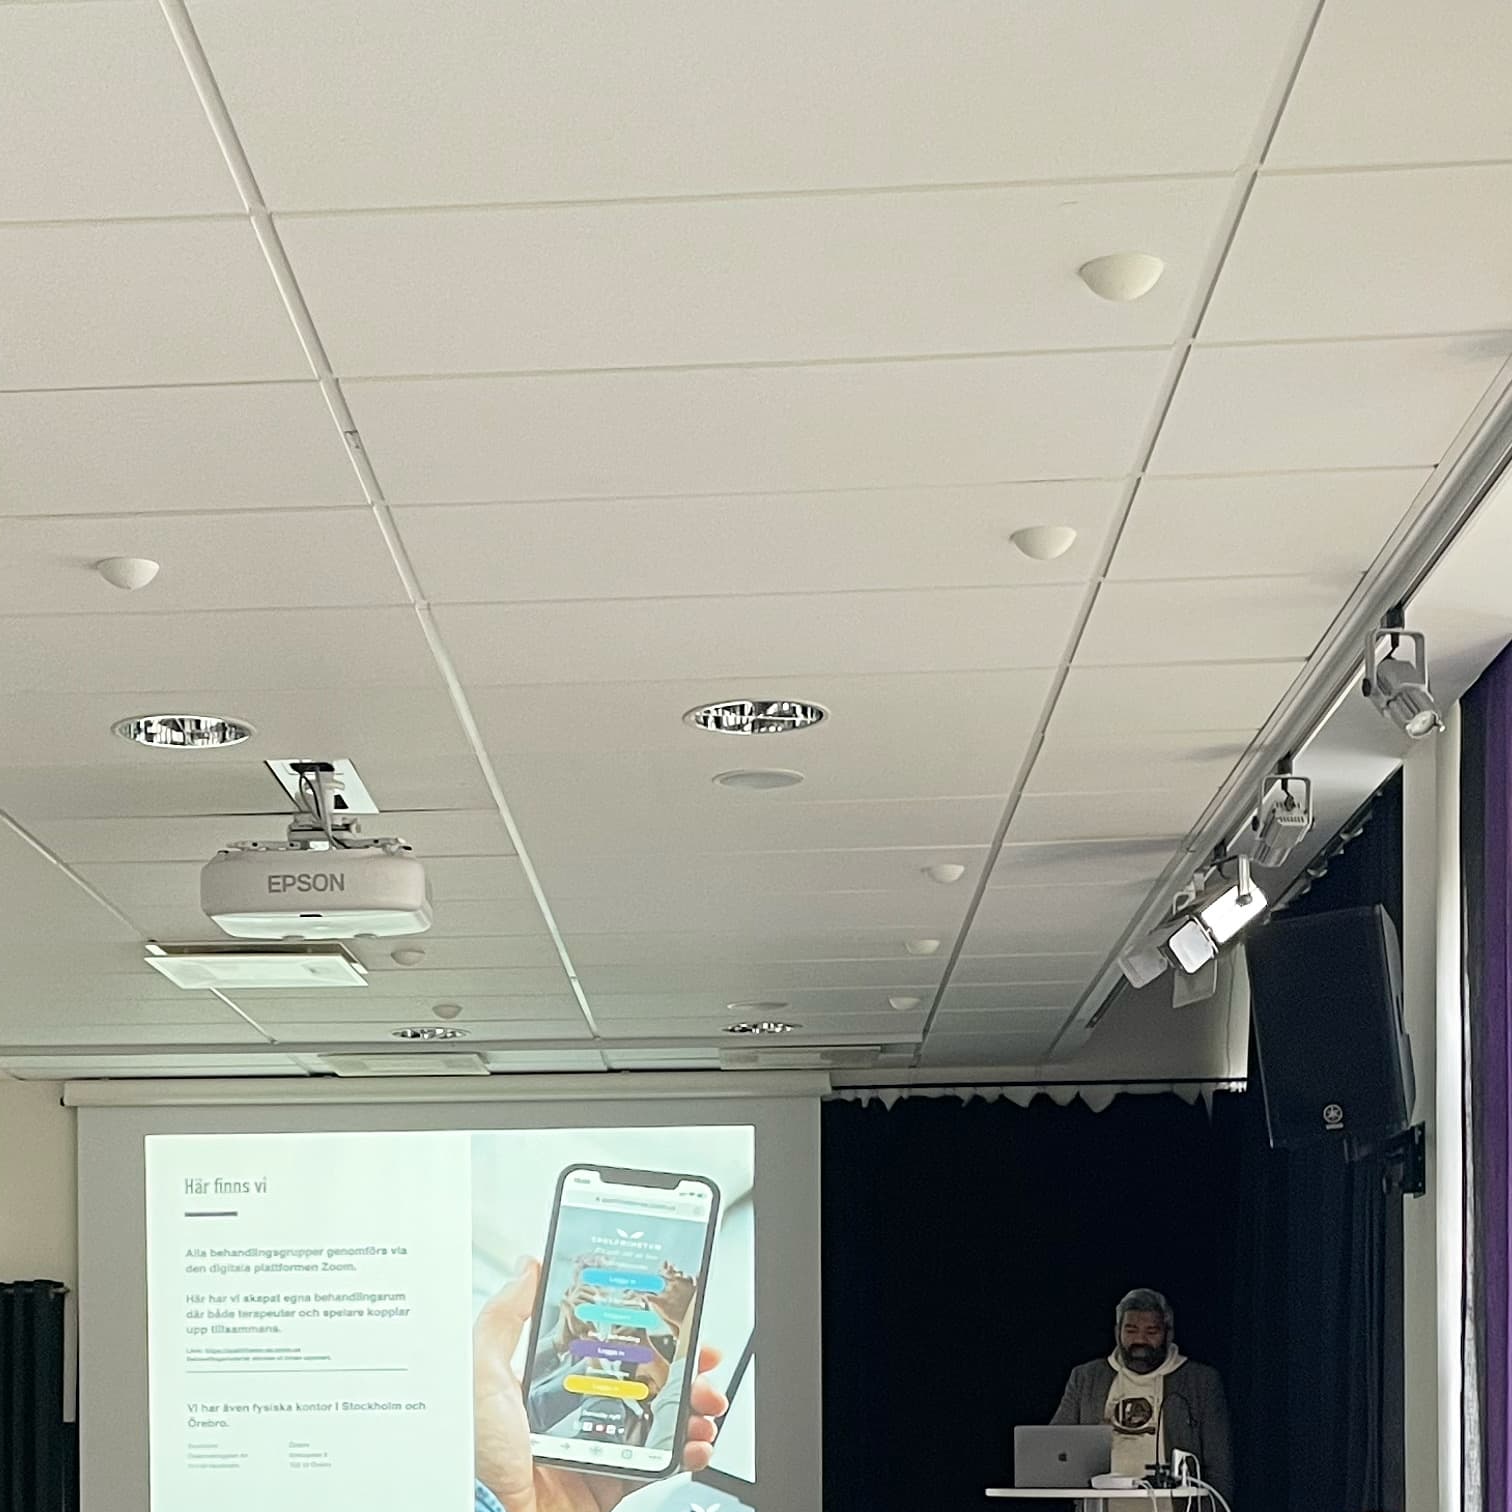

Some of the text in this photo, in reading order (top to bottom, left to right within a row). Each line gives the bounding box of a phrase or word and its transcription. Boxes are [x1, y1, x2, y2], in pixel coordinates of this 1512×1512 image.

[268, 873, 345, 893] EPSON
[184, 1176, 267, 1194] Här finns vi
[185, 1246, 407, 1260] Alla behandlingsgrupper genomförs via
[185, 1262, 357, 1276] den digitala plattformen Zoom.
[186, 1292, 406, 1305] Här har vi skapat egna behandlingsrum
[186, 1307, 410, 1320] där både terapeuter och spelare kopplar
[186, 1324, 283, 1335] upp tillsammans.
[187, 1403, 199, 1413] Vi
[201, 1403, 220, 1413] har
[223, 1402, 250, 1413] även
[252, 1402, 293, 1415] fysiska
[296, 1402, 332, 1412] kontor
[341, 1401, 402, 1411] Stockholm
[405, 1401, 426, 1411] och
[187, 1417, 230, 1428] Örebro.
